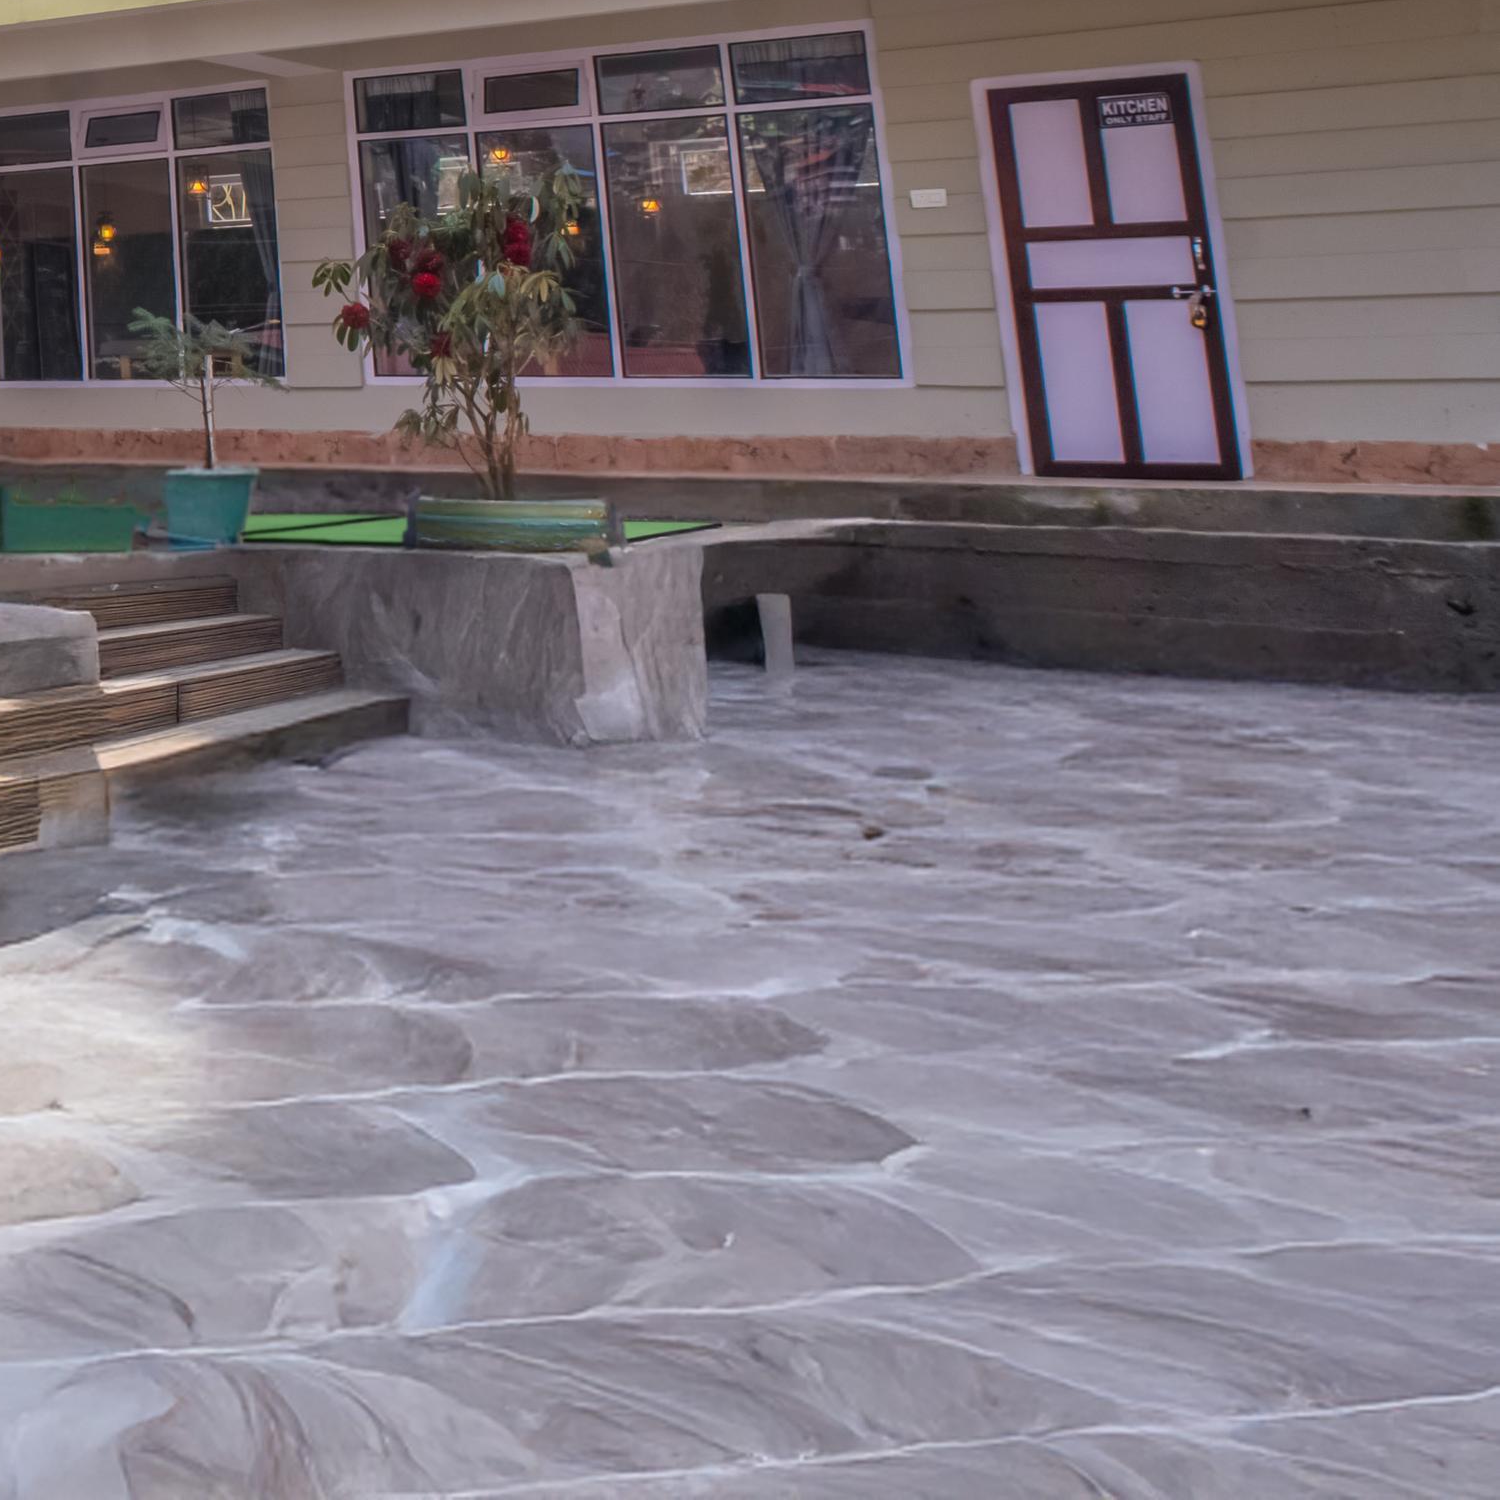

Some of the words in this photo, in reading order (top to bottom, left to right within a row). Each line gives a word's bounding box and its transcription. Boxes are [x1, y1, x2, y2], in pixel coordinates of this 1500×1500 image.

[1102, 98, 1168, 115] KITCHEN
[1105, 115, 1133, 125] ONLY
[1135, 113, 1167, 123] STAFF
